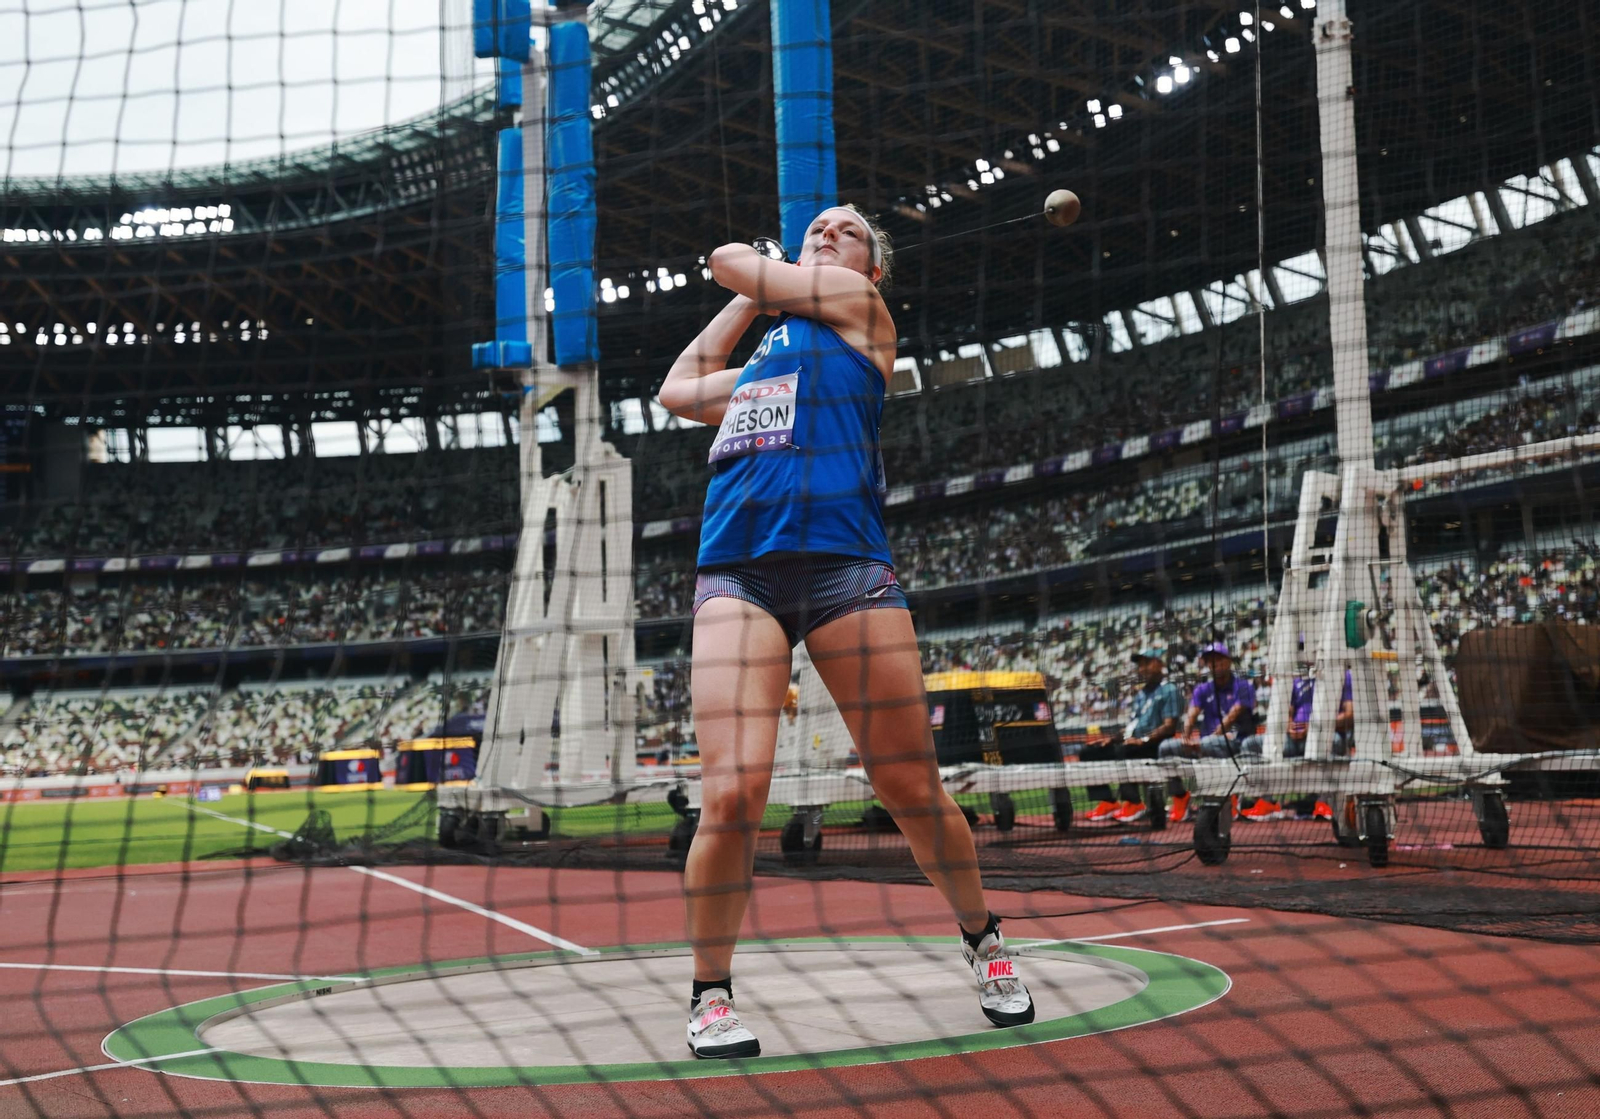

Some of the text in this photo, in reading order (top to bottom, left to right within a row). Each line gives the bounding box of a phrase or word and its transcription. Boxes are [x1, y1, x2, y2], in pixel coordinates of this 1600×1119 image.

[750, 324, 790, 365] SA
[727, 383, 793, 411] ONDA
[723, 405, 789, 436] HESON
[988, 961, 1013, 978] NIKE
[700, 1006, 731, 1028] NIKE
